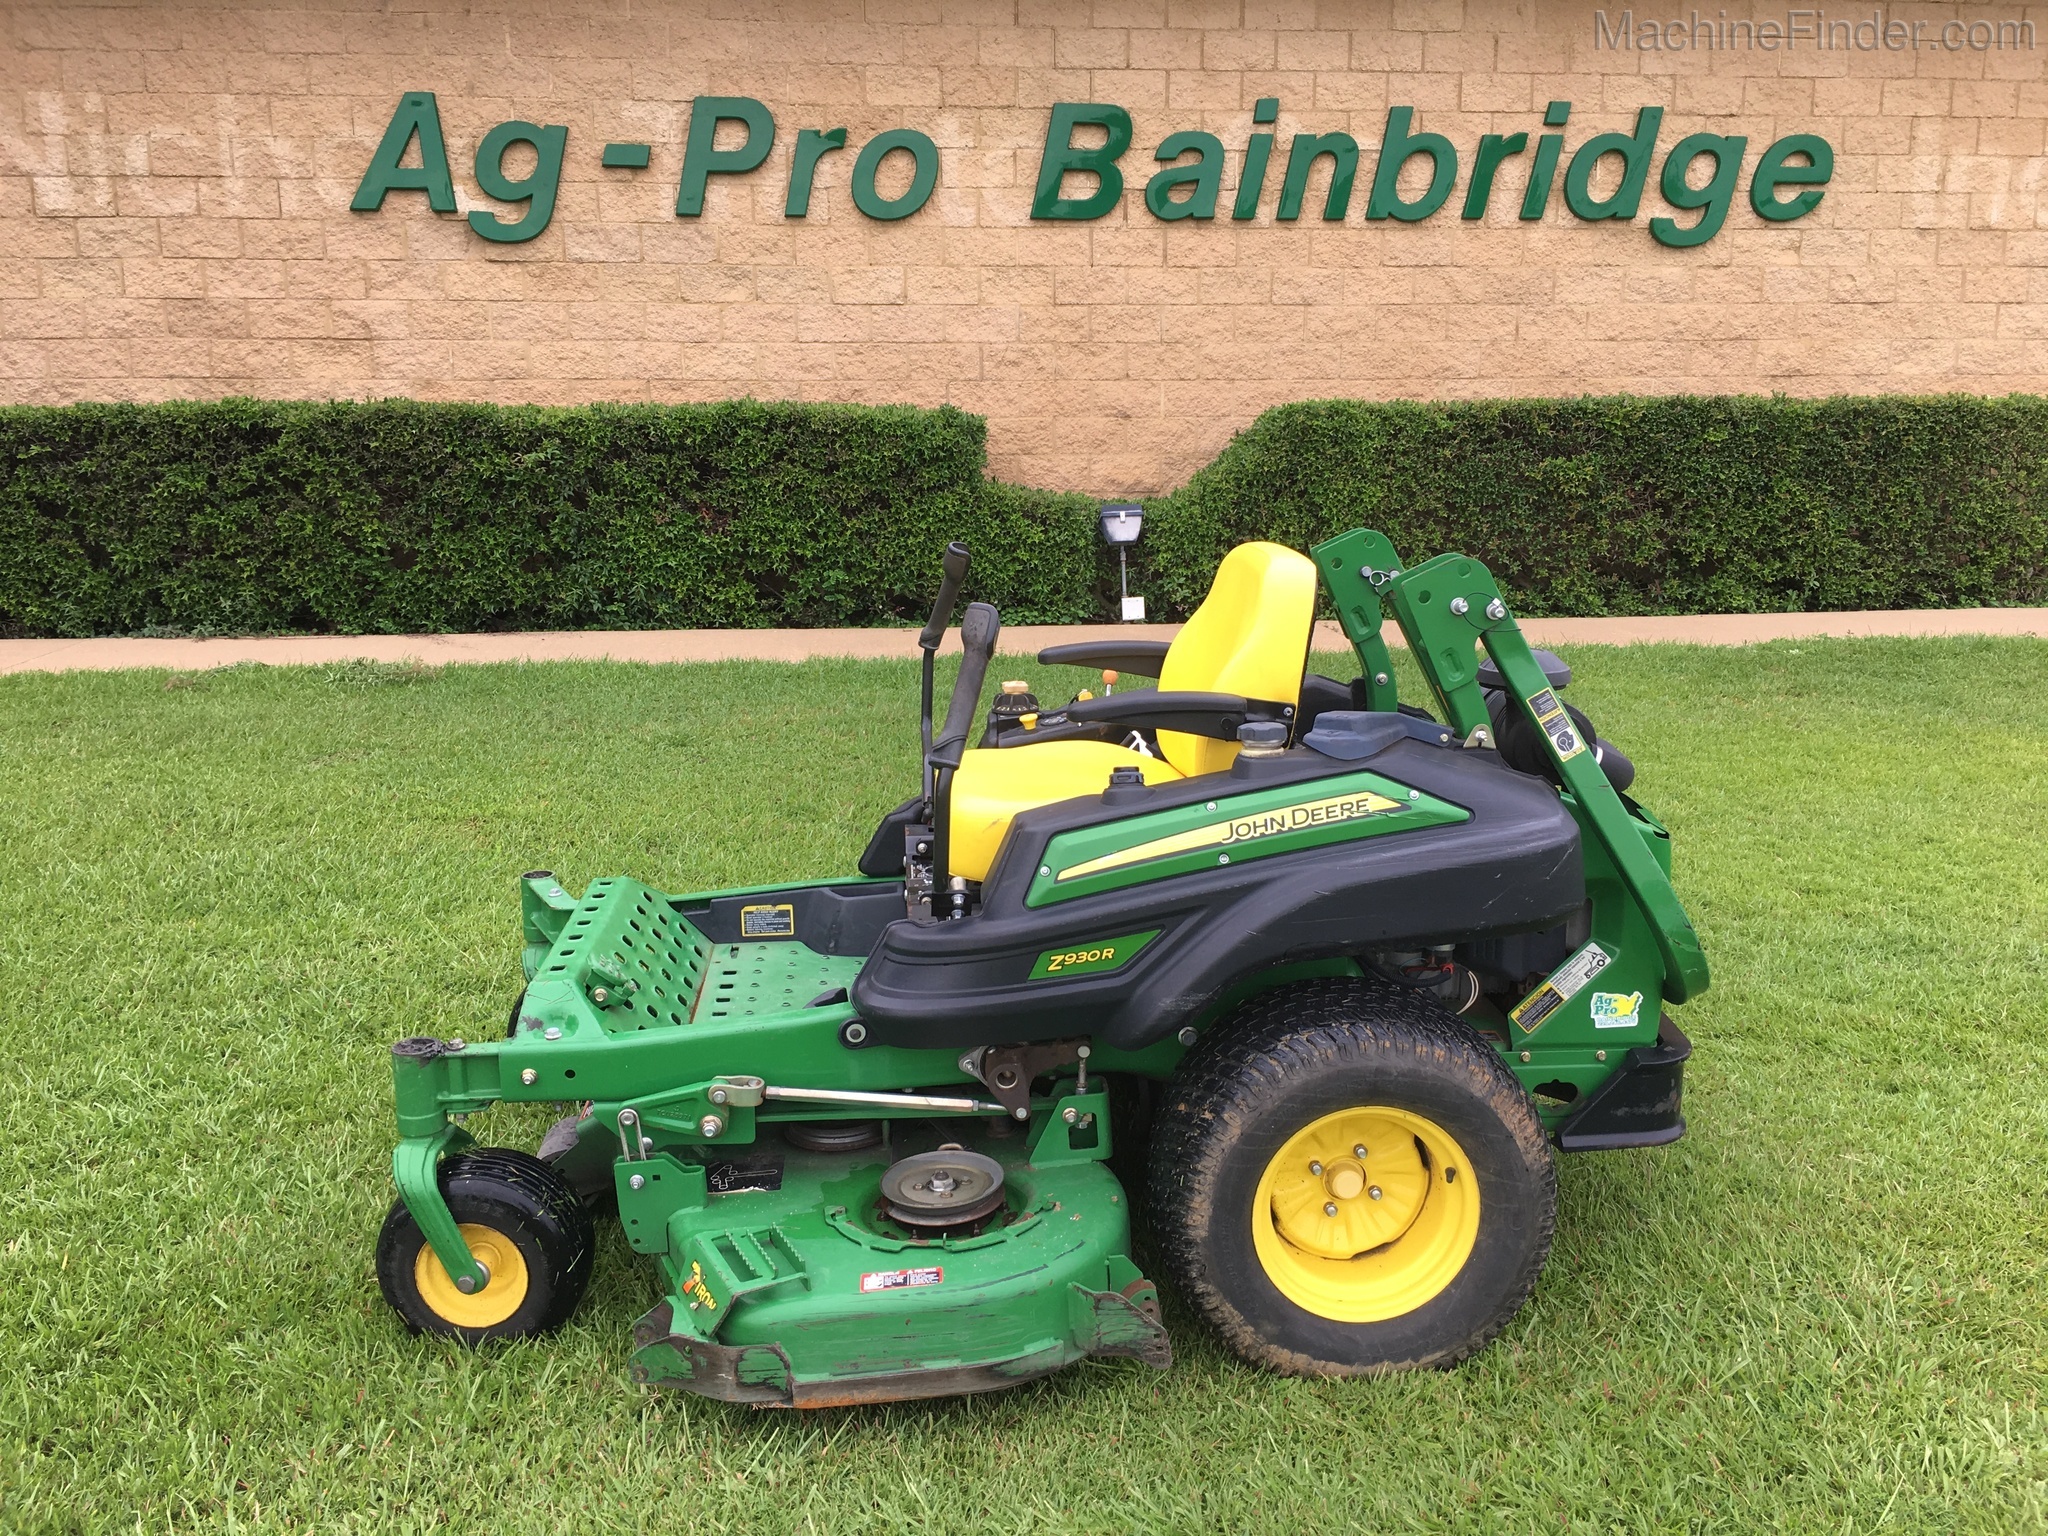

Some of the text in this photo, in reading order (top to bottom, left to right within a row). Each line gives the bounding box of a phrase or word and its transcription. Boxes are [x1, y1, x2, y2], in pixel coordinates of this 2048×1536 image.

[1029, 97, 1835, 248] Bainbridge
[1221, 798, 1370, 842] JOHN DEERE
[1046, 947, 1115, 971] Z930R
[1594, 1005, 1618, 1016] Pro
